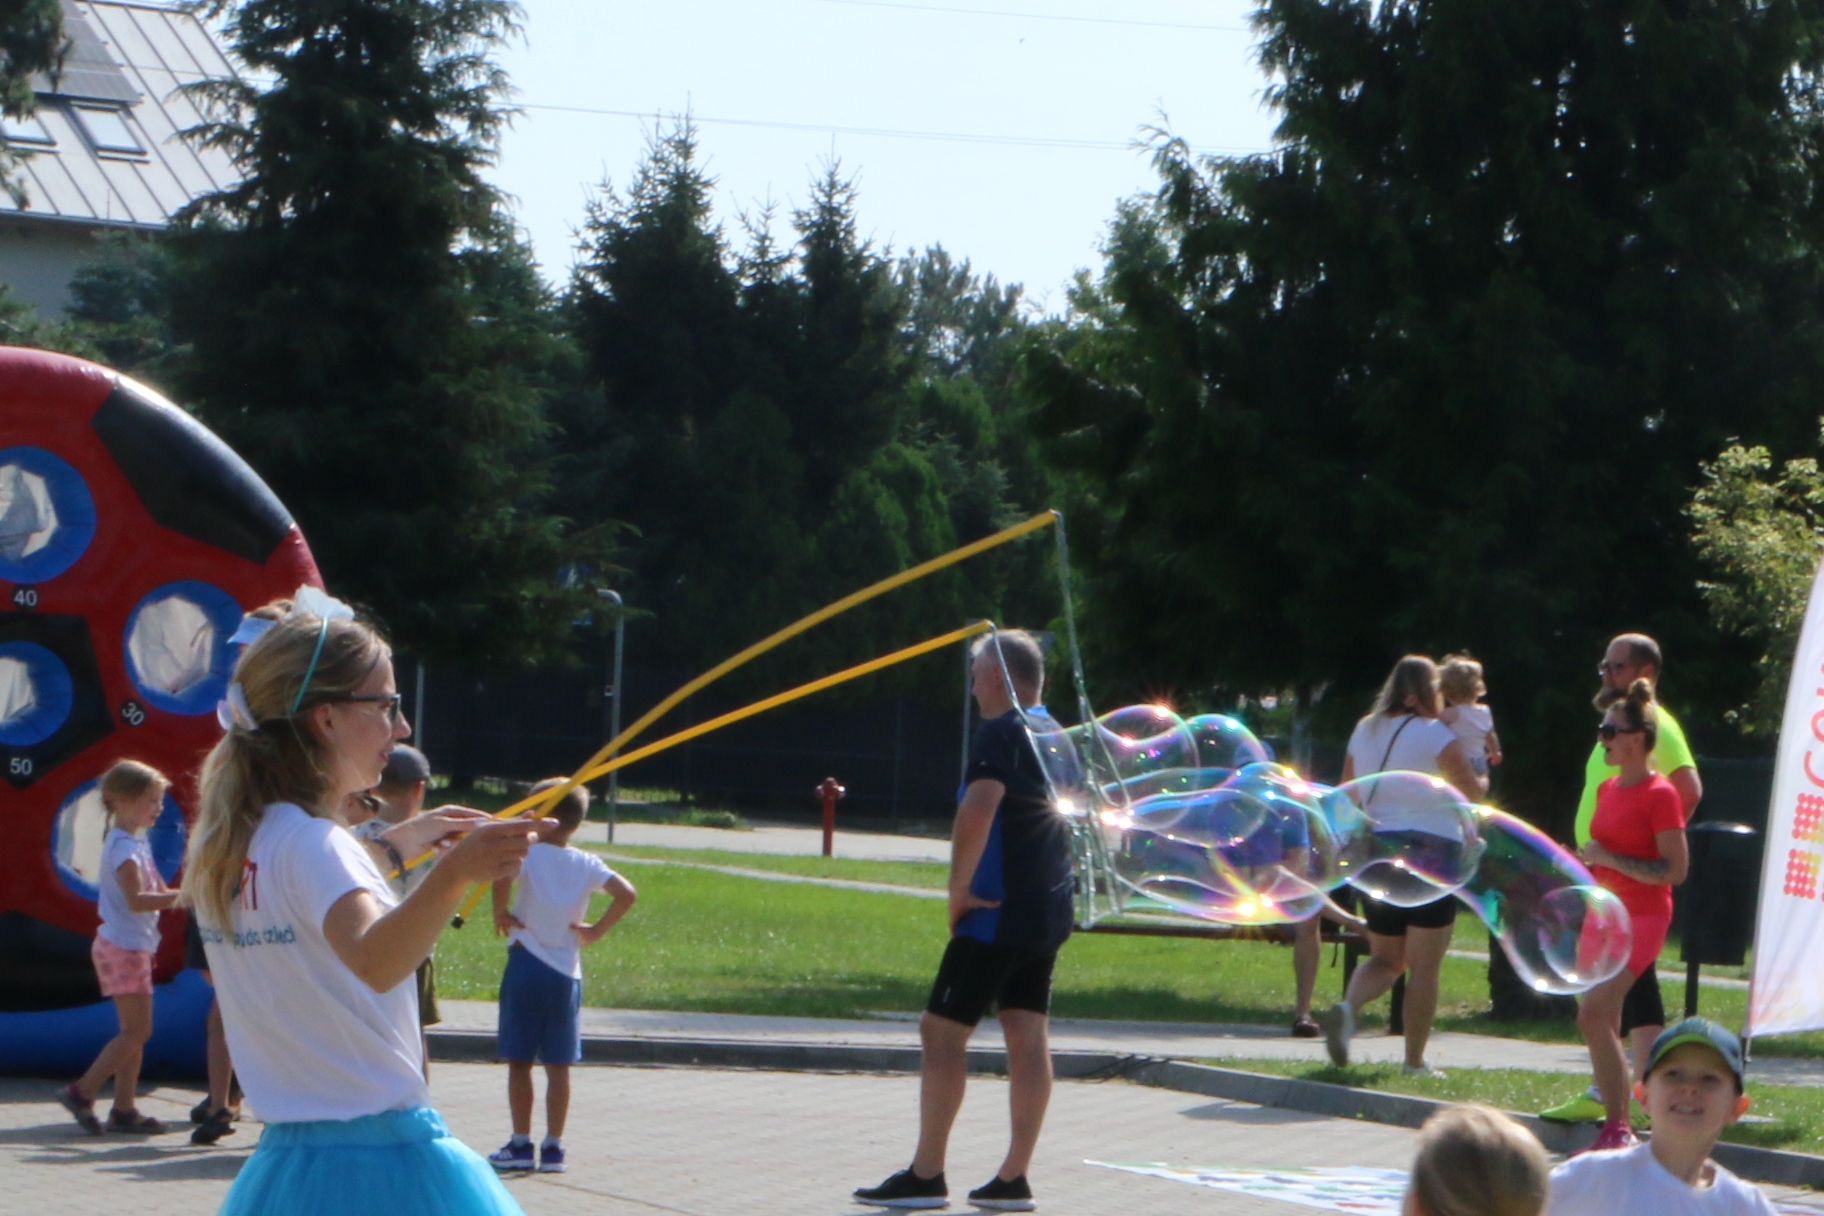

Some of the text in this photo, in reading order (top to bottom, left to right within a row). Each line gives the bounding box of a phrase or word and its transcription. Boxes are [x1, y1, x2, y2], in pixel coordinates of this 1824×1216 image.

[14, 589, 38, 607] 40
[122, 702, 144, 726] 30
[10, 758, 32, 775] 50
